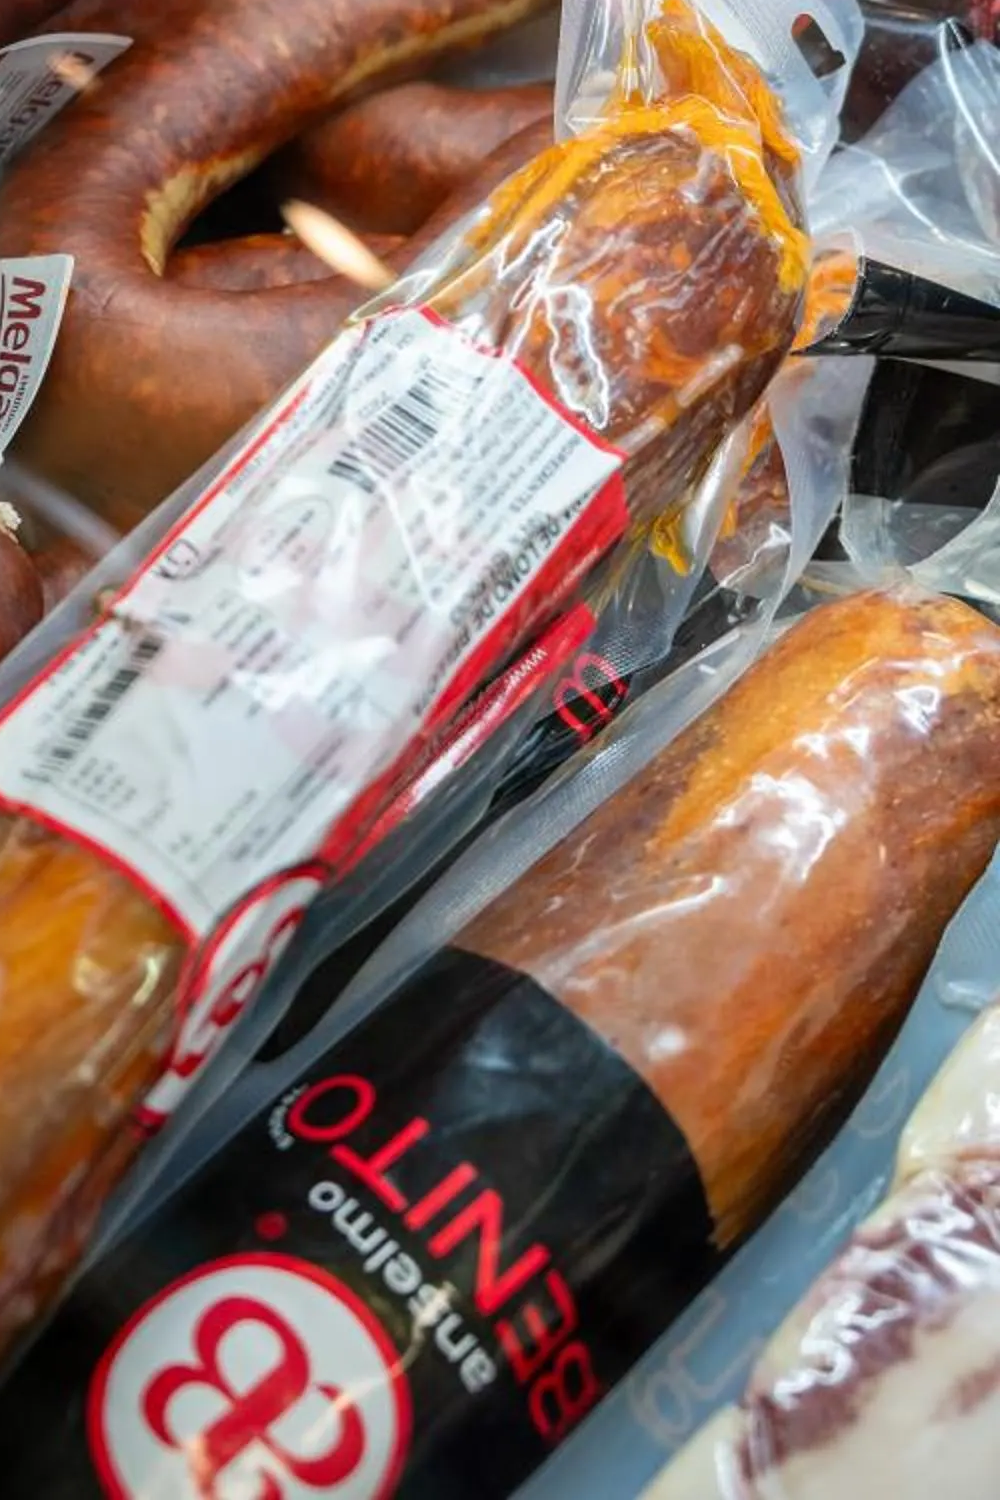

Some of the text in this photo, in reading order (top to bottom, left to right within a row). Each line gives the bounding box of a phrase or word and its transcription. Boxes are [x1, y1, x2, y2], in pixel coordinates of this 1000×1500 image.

[494, 540, 539, 603] LOMO
[291, 1072, 605, 1441] BENITO
[303, 1177, 501, 1394] anselmo
